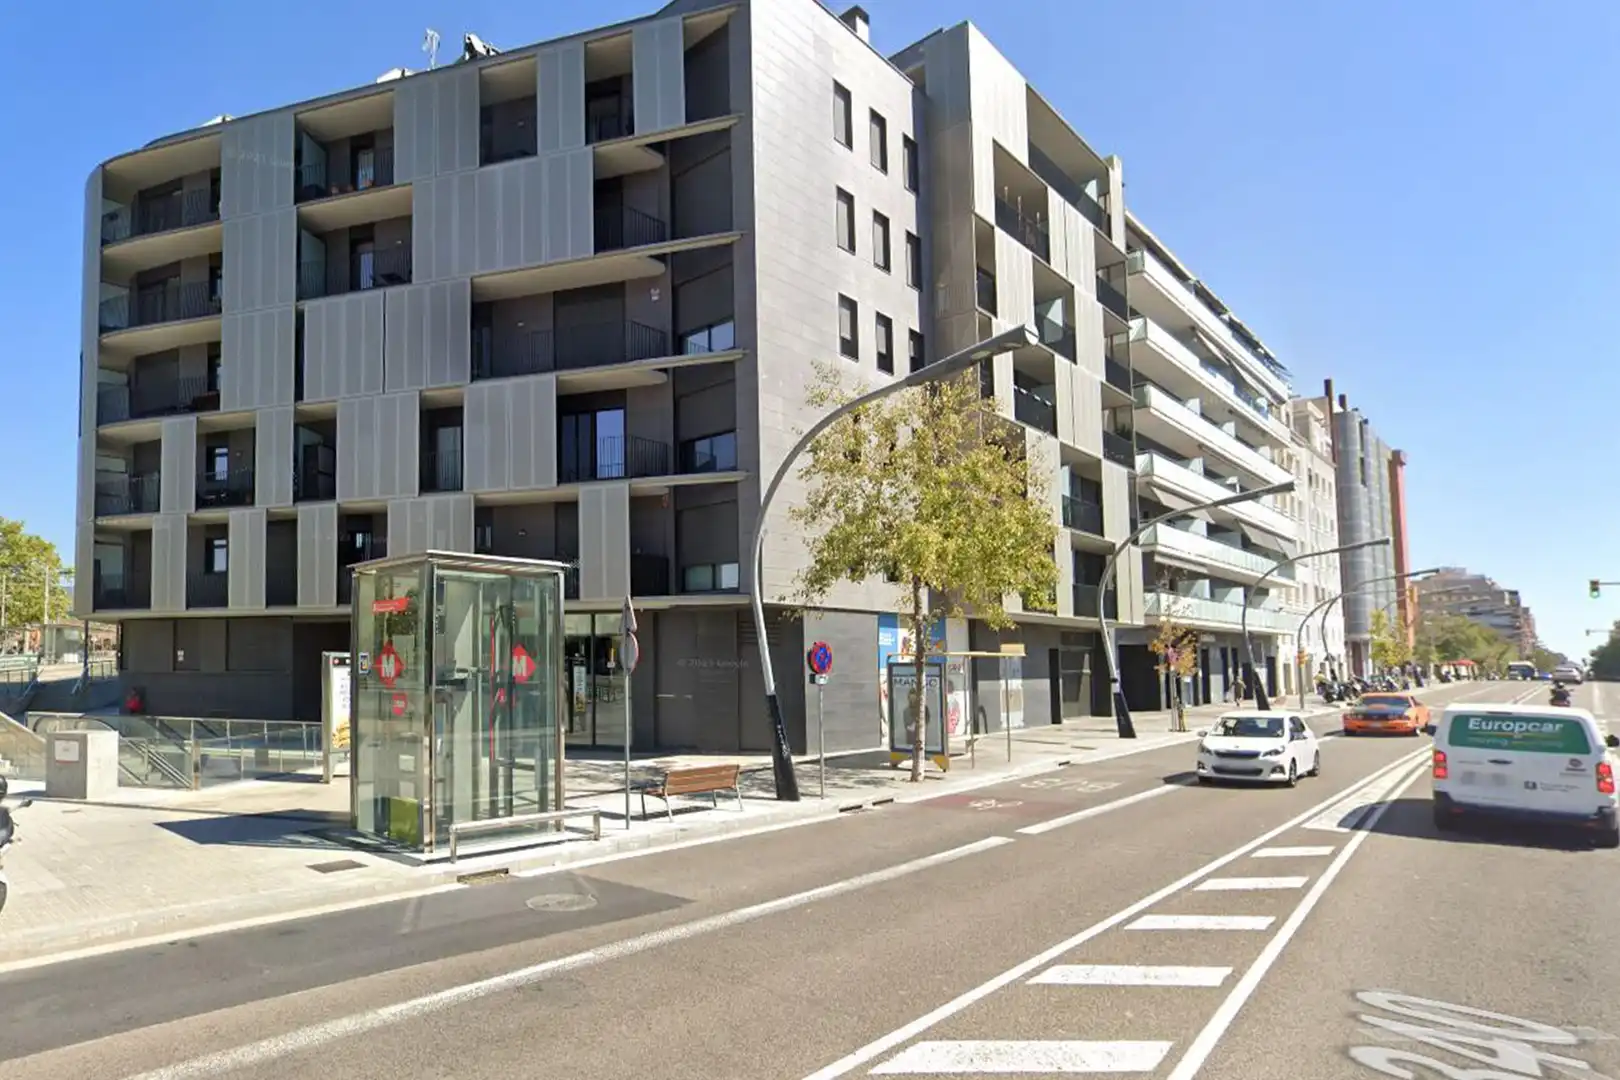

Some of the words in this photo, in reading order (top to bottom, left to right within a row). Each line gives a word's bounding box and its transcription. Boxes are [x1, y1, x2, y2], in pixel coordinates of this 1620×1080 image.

[382, 654, 395, 677] M
[512, 655, 527, 677] M
[893, 678, 938, 689] MANO
[1468, 718, 1564, 734] Europcar
